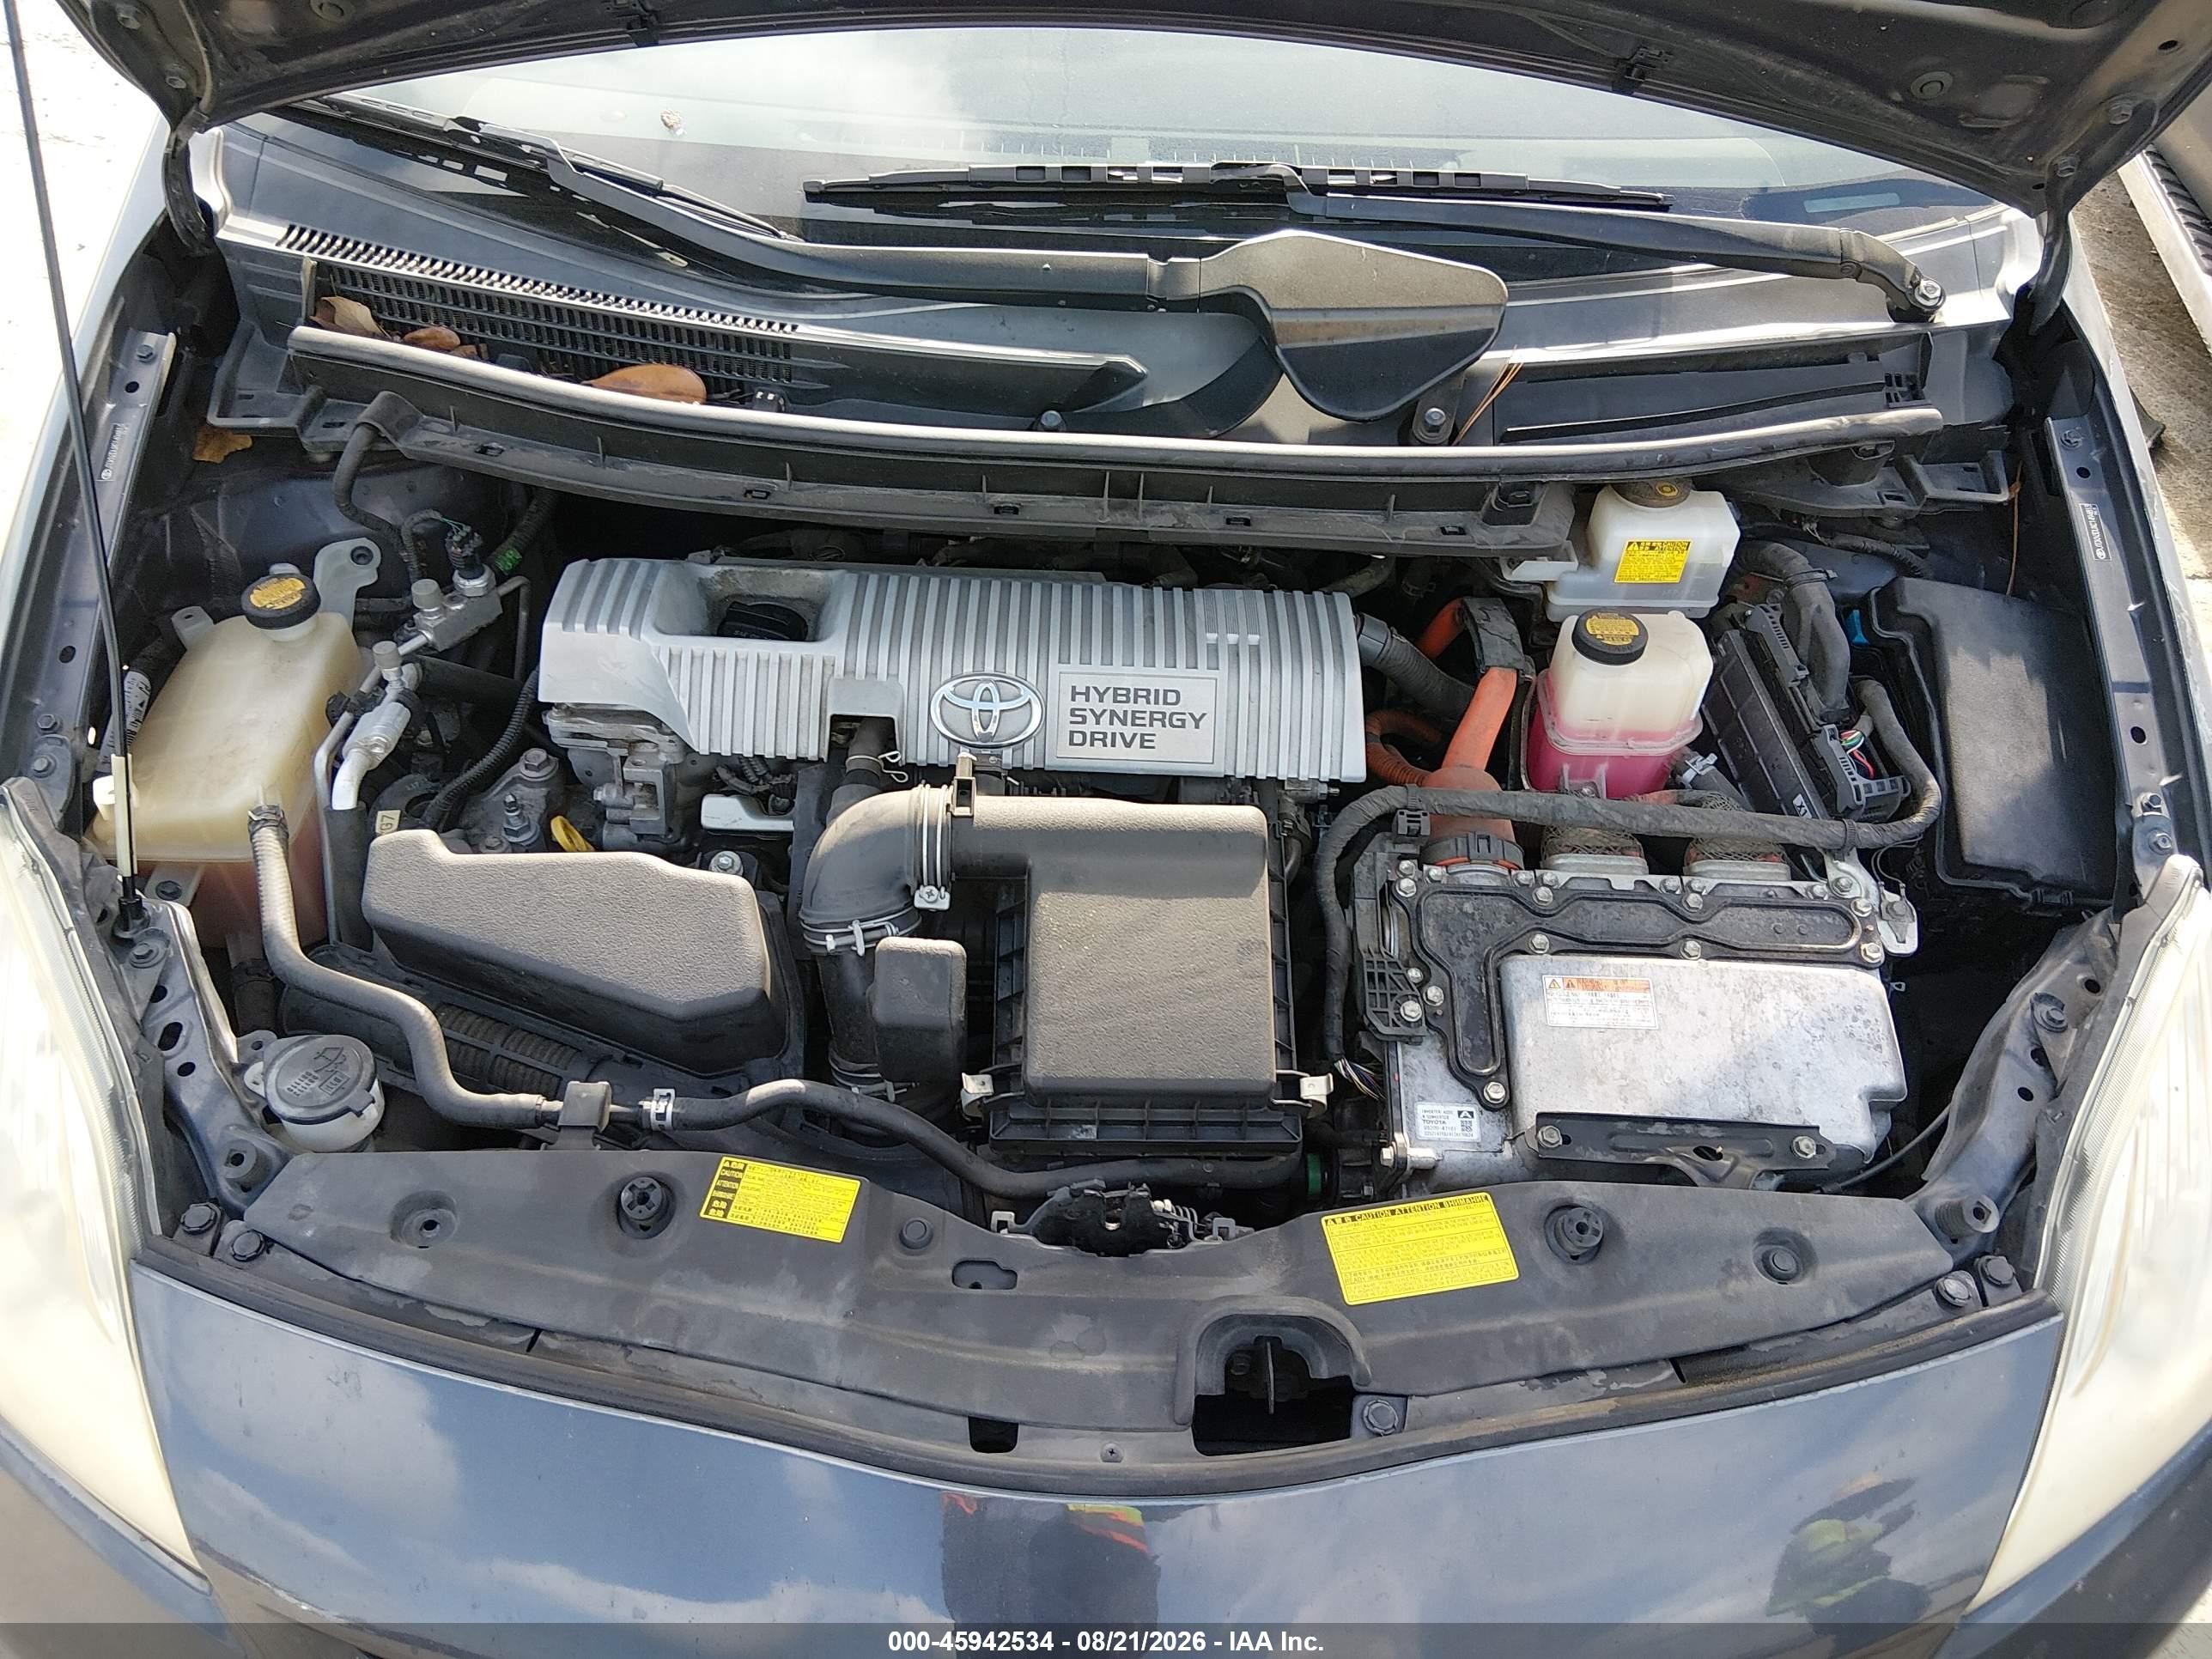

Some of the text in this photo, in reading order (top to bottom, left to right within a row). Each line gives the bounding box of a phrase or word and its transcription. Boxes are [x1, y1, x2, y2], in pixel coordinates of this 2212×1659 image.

[1071, 685, 1181, 706] HYBRID
[1069, 708, 1207, 730] SYNERGY
[1068, 730, 1157, 750] DRIVE
[1356, 1210, 1391, 1221] CAUTION
[1395, 1201, 1440, 1215] ATTENTION
[1443, 1194, 1487, 1209] ВНИМАНИЕ
